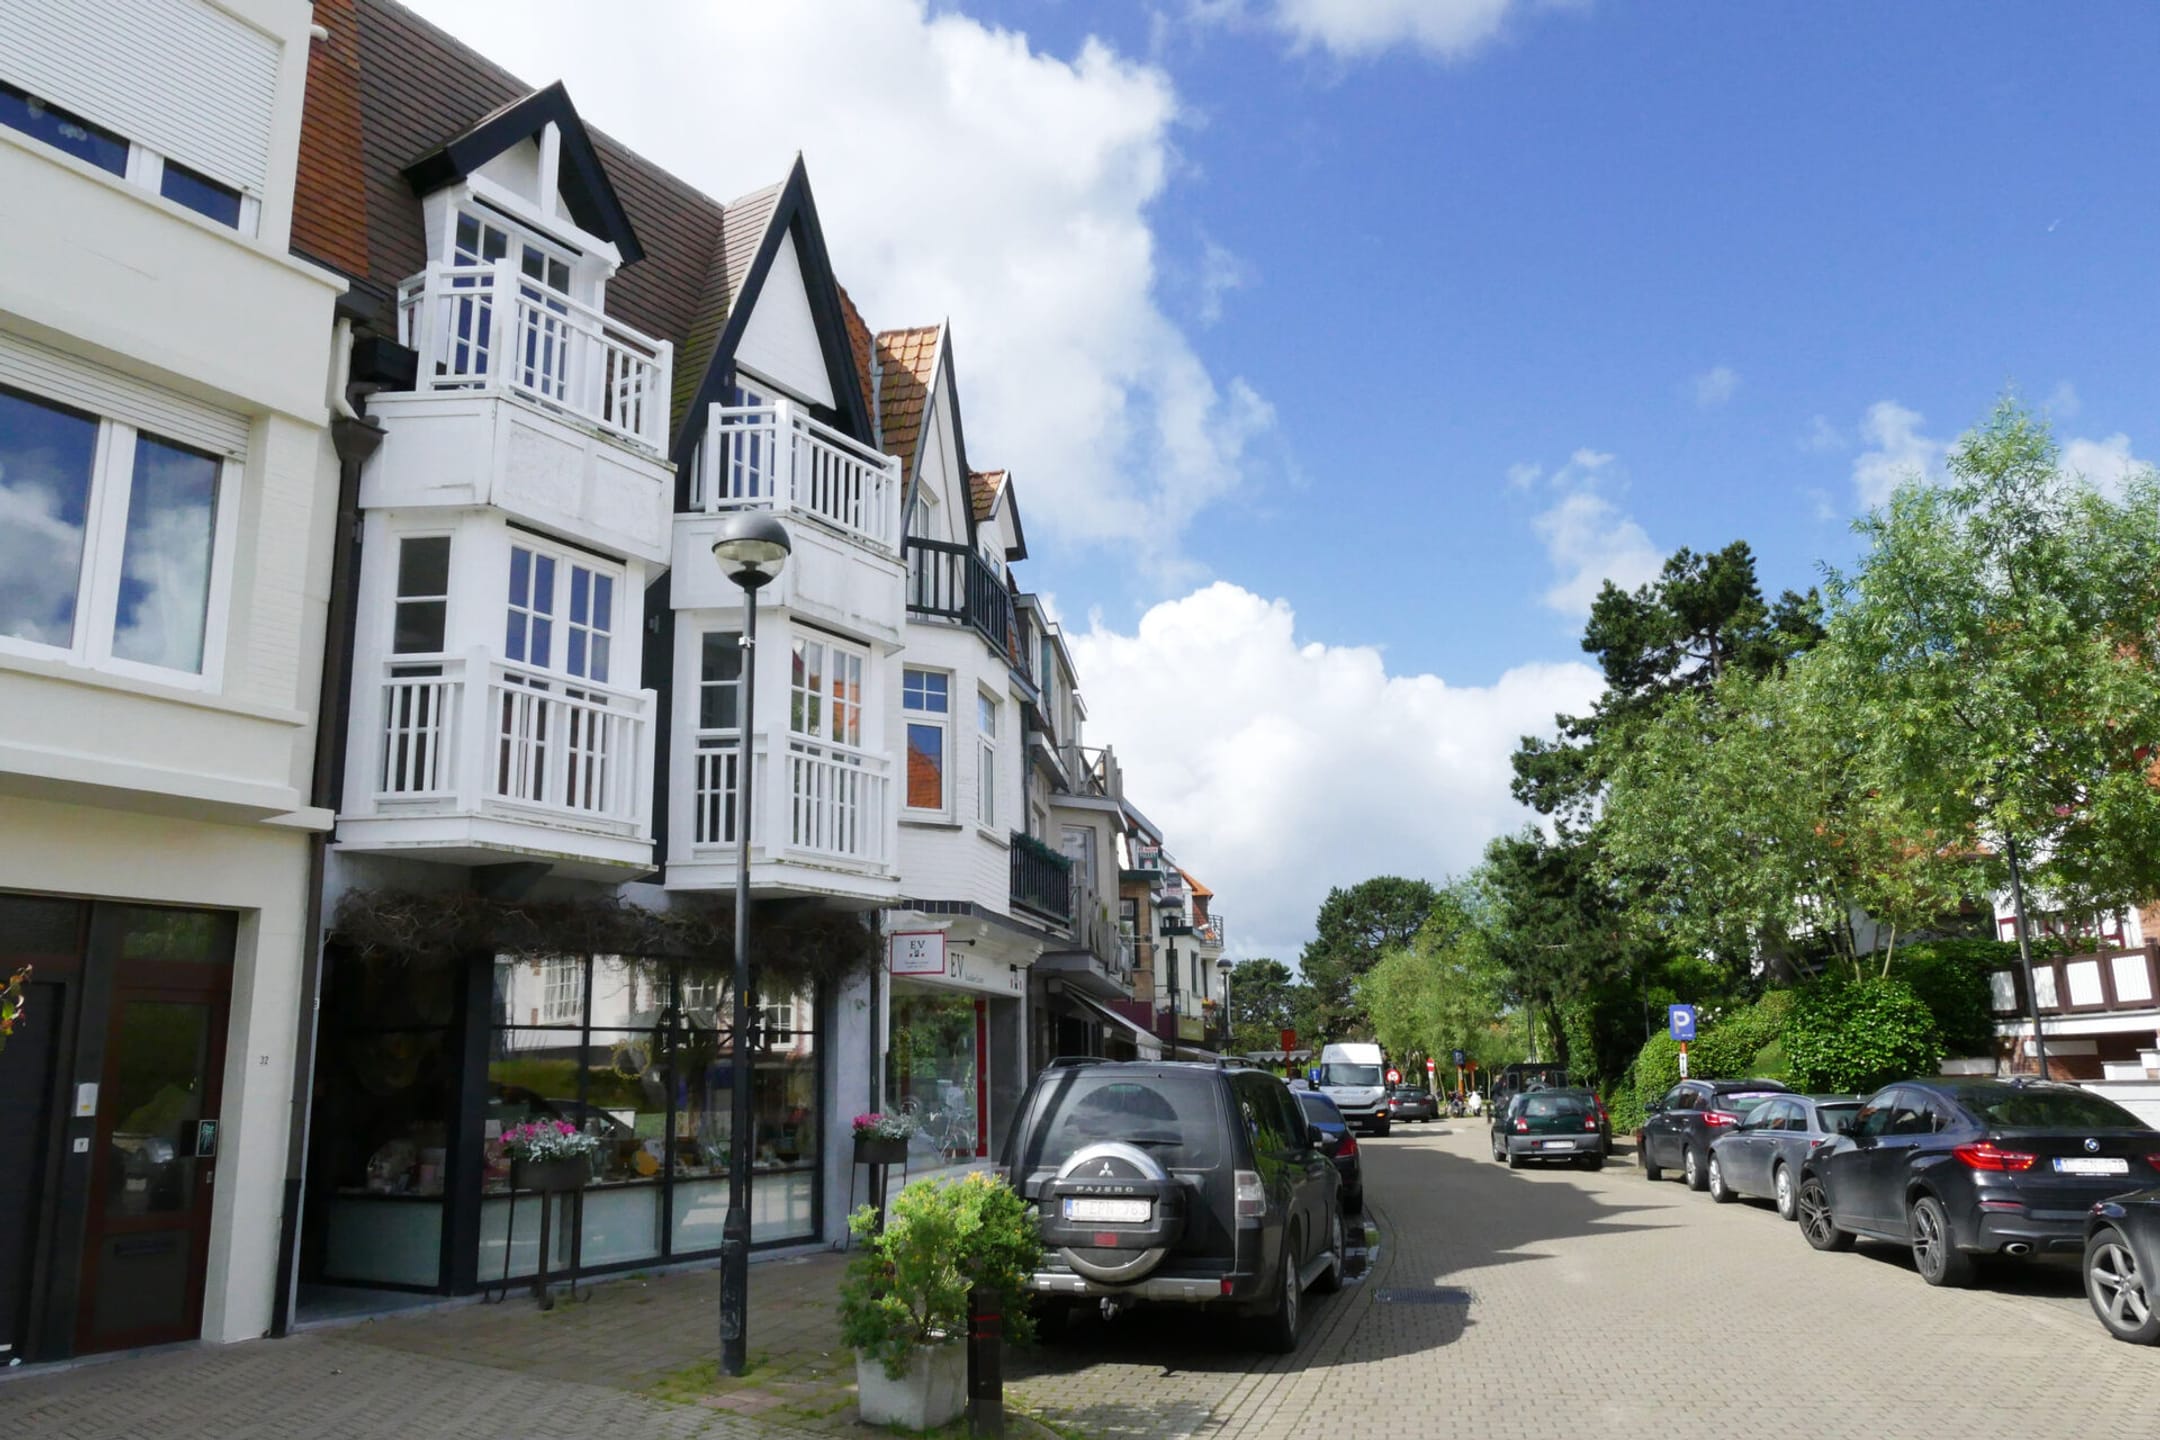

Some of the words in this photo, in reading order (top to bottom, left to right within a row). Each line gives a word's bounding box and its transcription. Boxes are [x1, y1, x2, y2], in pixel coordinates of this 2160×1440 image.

[910, 940, 926, 950] EV
[950, 952, 965, 979] EV
[1673, 1010, 1691, 1034] P
[1076, 1185, 1134, 1193] PAJERO
